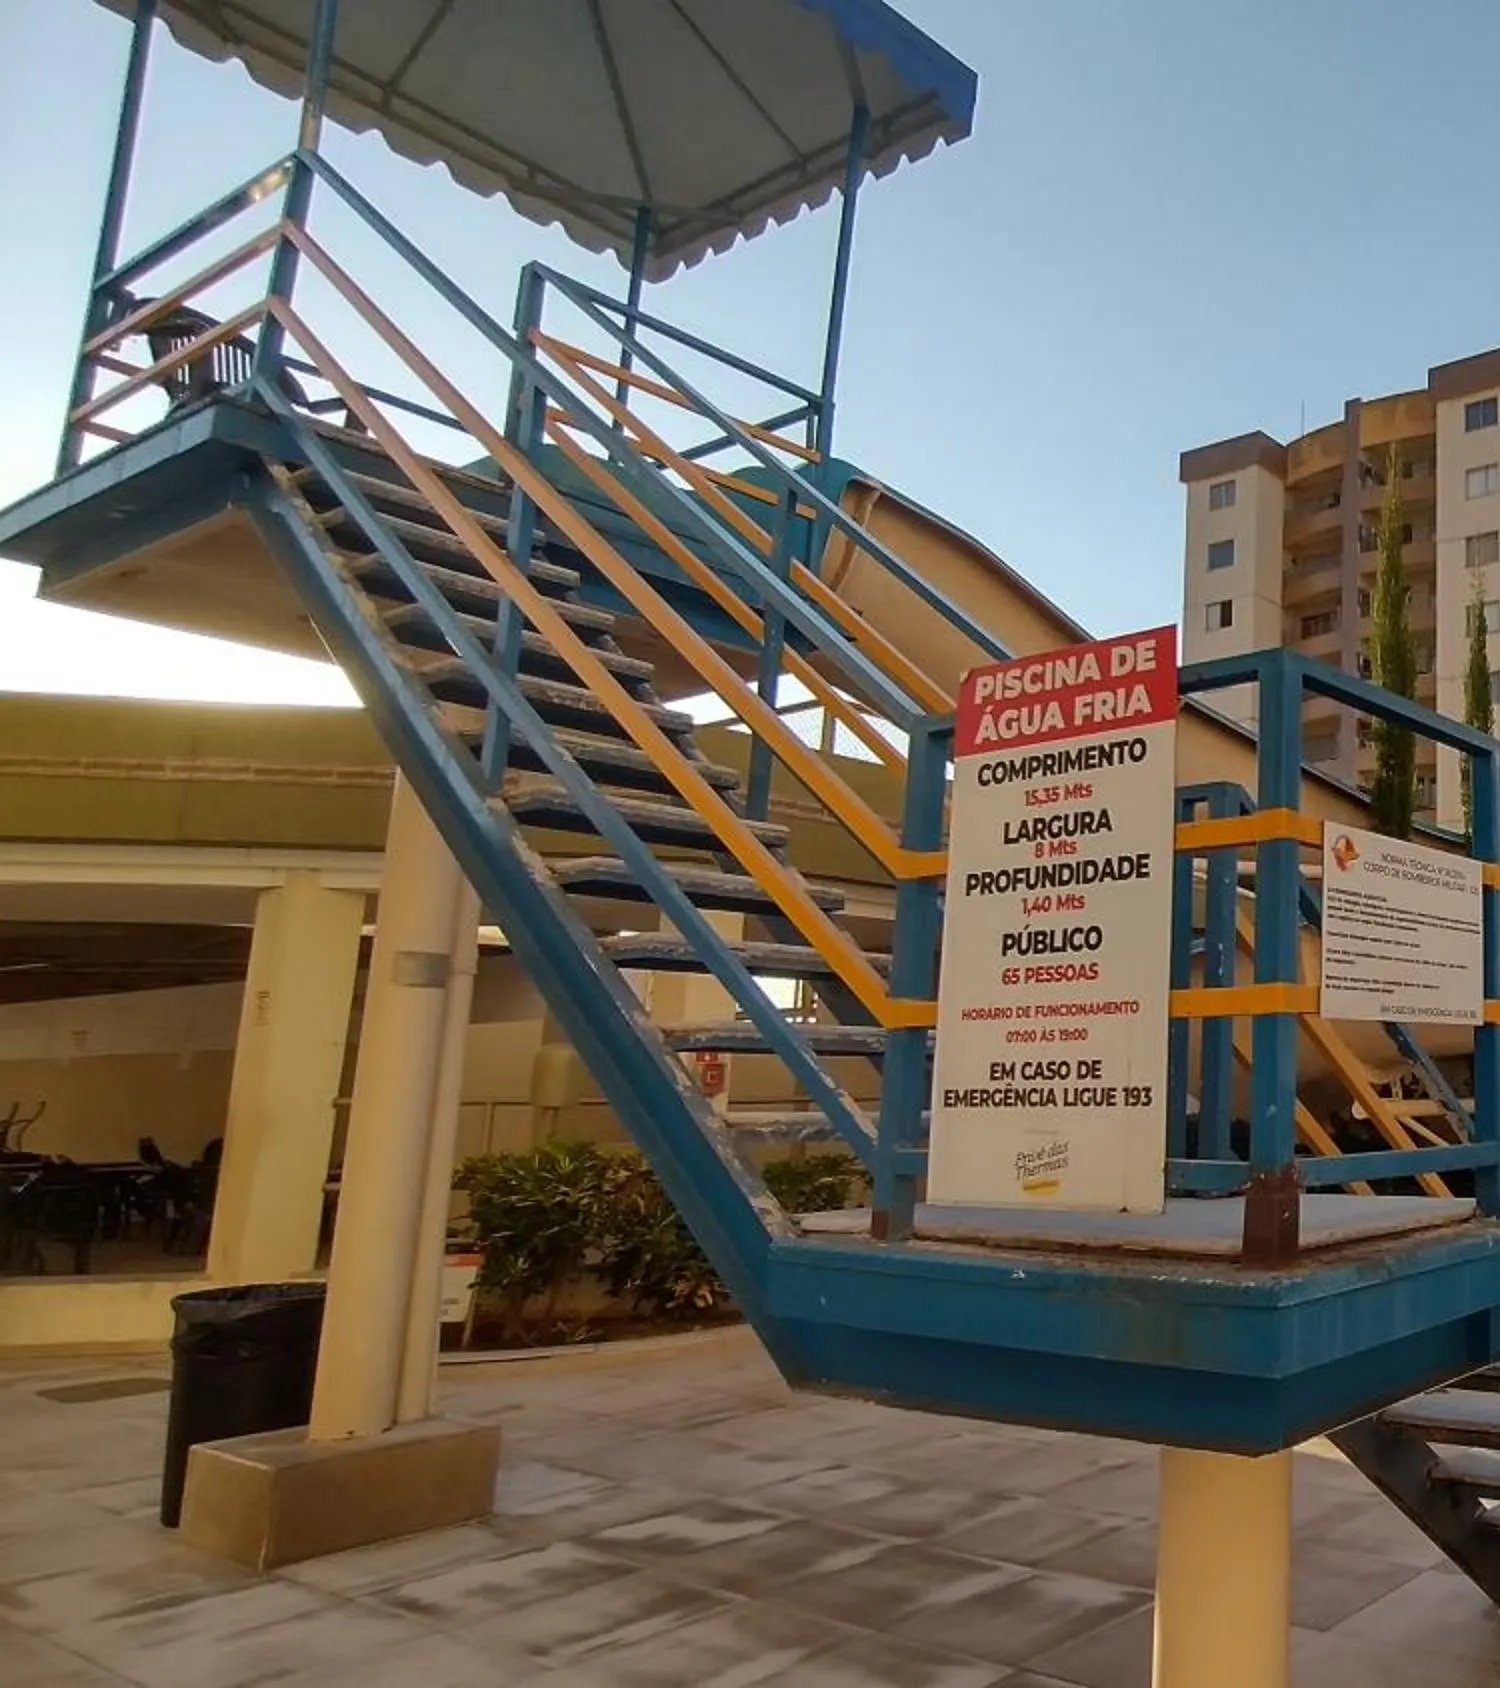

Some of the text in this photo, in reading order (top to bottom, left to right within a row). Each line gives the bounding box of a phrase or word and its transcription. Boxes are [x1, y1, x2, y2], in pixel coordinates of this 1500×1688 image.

[975, 640, 1157, 705] PISCINA DE
[975, 684, 1152, 745] ÁGUA FRIA
[977, 737, 1148, 787] COMPRIMENTO
[1063, 783, 1093, 801] Mts
[1003, 808, 1113, 845] LARGURA
[1034, 839, 1077, 858] 8 Mts
[965, 853, 1151, 896] PROFUNDIDADE
[1363, 861, 1390, 876] CORPO
[1020, 893, 1086, 918] 1,40 Mts
[1001, 924, 1103, 957] PÚBLICO
[1001, 963, 1100, 986] 65 PESSOAS
[1015, 1006, 1031, 1019] DE
[1034, 1000, 1140, 1019] FUNCIONAMENTO
[989, 1059, 1102, 1082] EM CASO DE
[943, 1083, 1152, 1108] EMERGÊNCIA LIGUE 193
